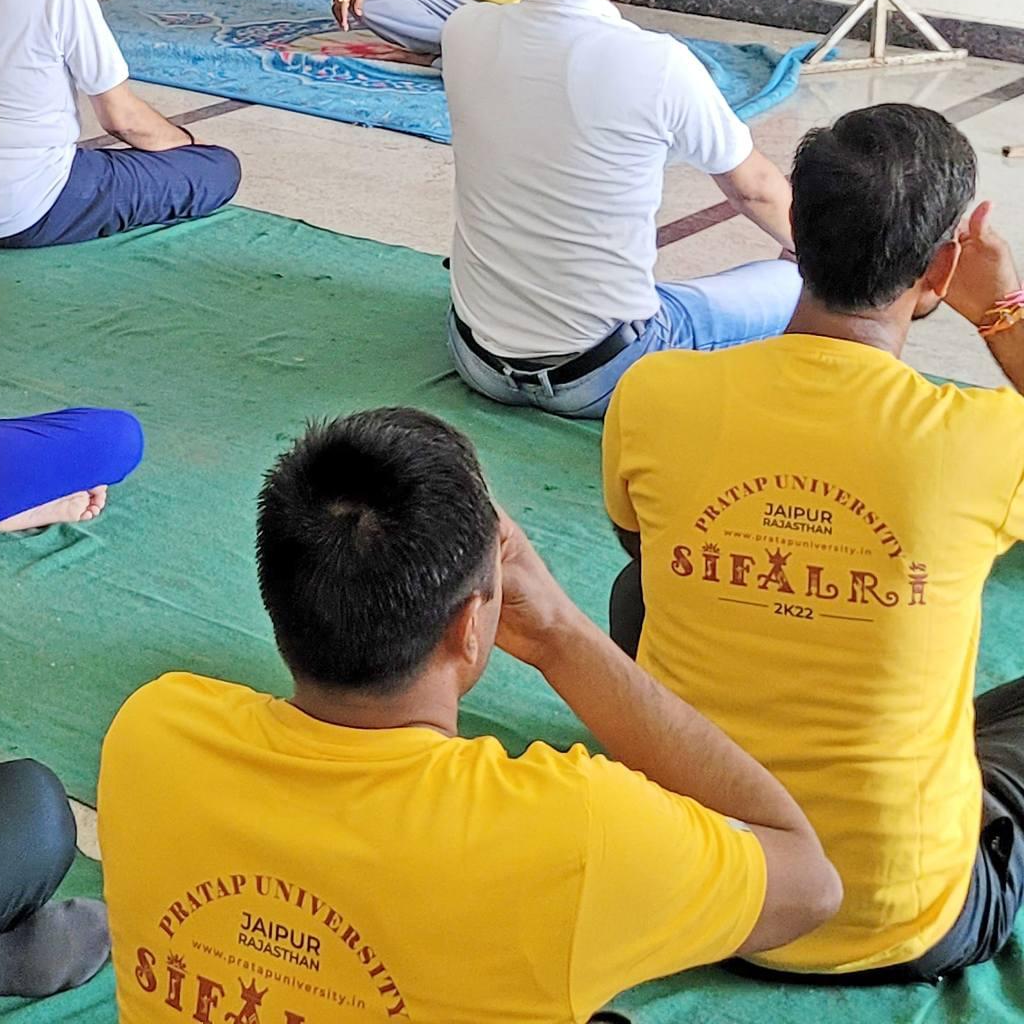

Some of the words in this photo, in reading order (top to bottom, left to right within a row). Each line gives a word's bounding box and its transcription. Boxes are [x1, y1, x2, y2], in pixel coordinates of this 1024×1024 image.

[694, 476, 769, 533] PRATAP
[775, 475, 904, 559] UNIVERSITY
[762, 517, 833, 536] RAJASTHAN
[764, 502, 833, 524] JAIPUR
[773, 602, 815, 620] 2K22
[158, 874, 247, 938] PRATAP
[255, 874, 411, 1019] UNIVERSITY
[238, 932, 320, 972] RAJASTHAN
[240, 911, 321, 956] JAIPUR
